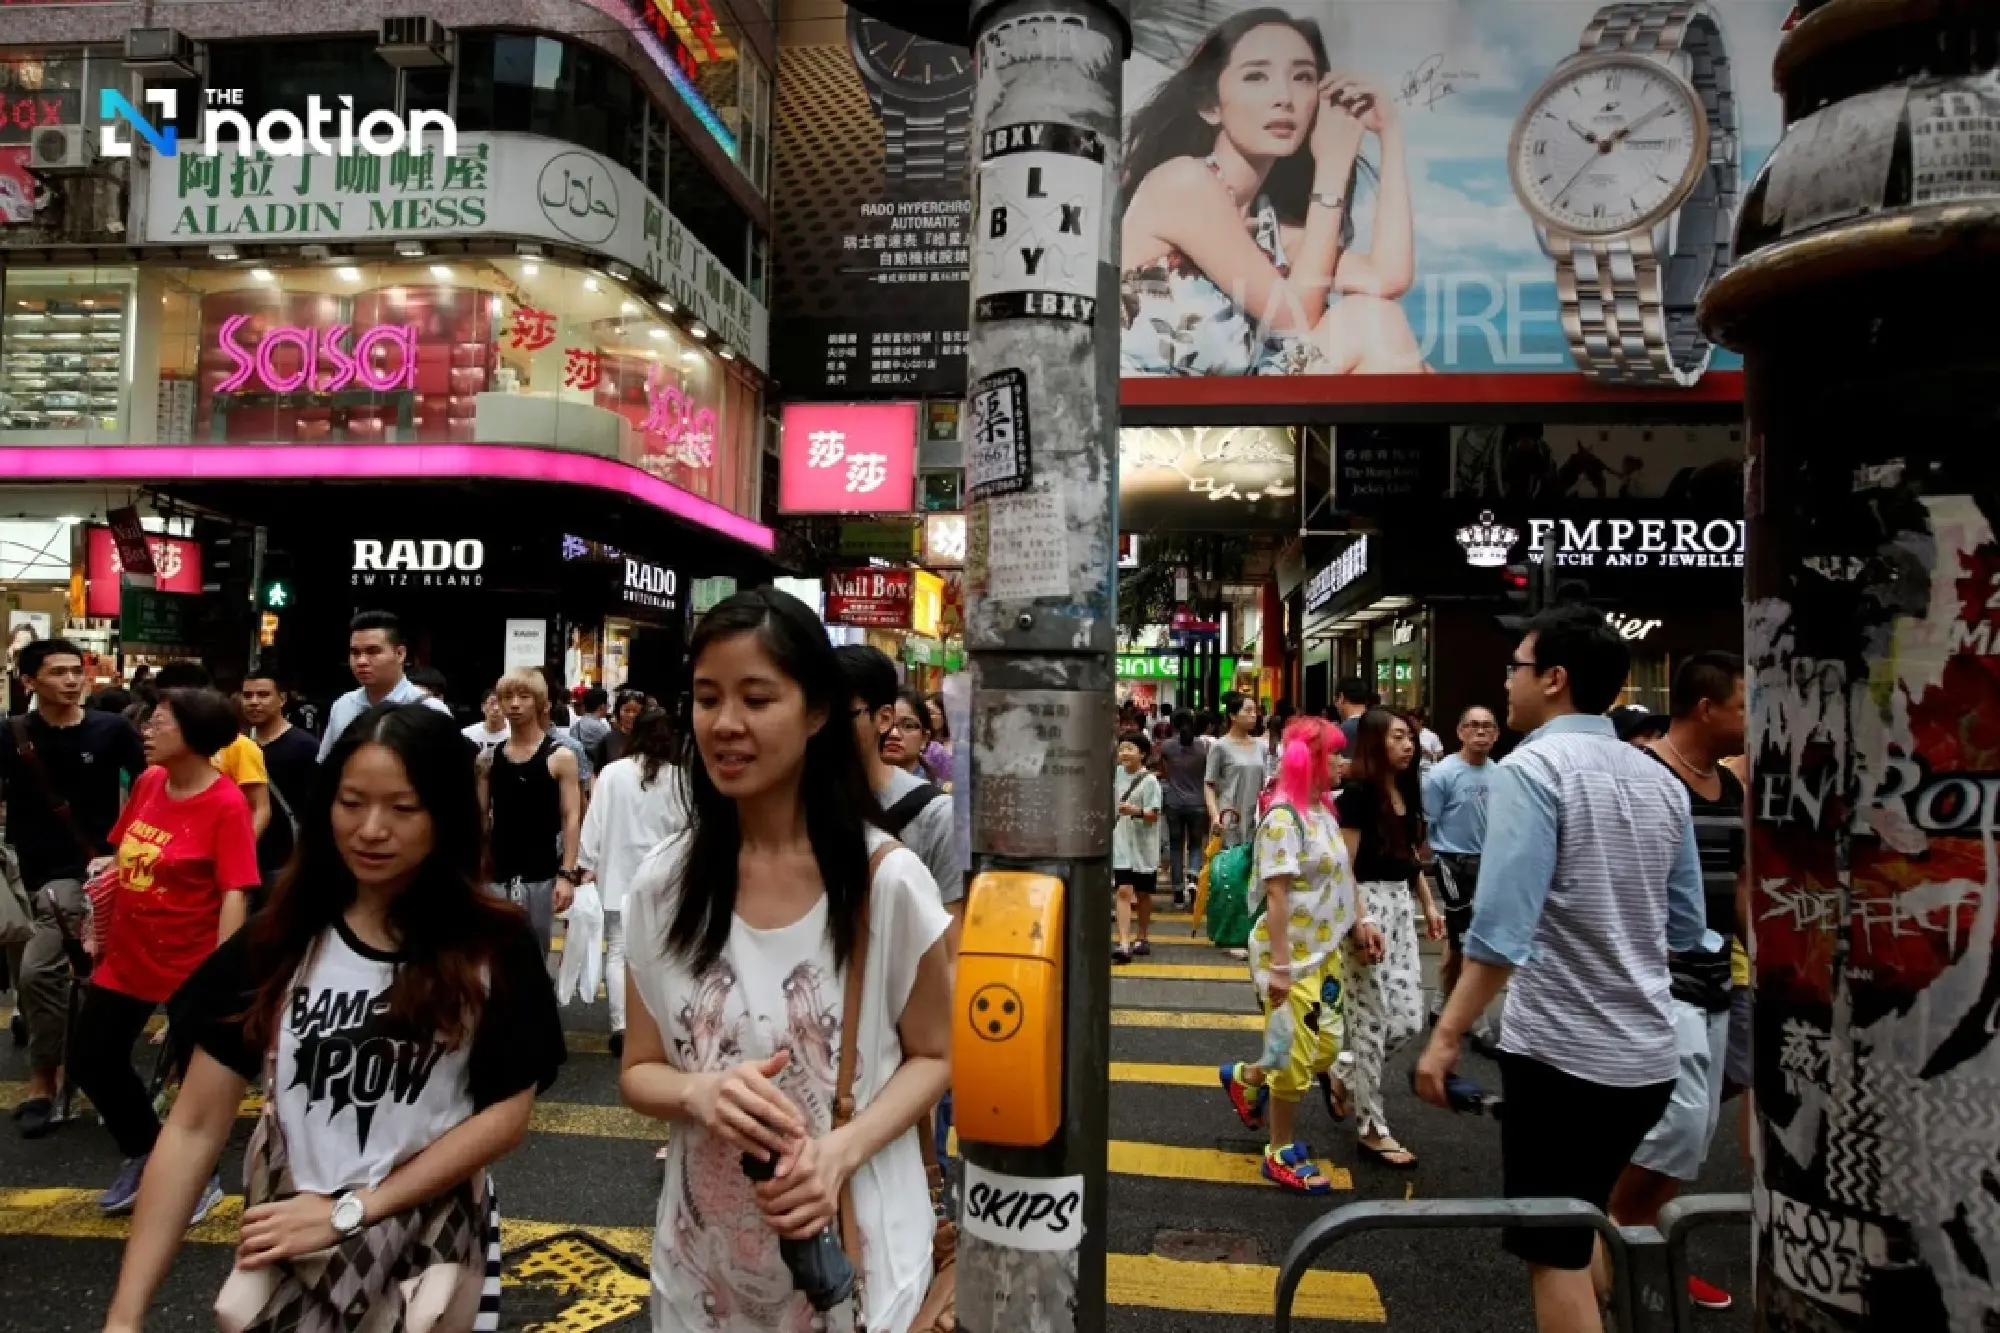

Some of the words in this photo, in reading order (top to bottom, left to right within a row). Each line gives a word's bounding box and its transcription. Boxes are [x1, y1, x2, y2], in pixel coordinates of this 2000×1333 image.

[984, 123, 1044, 155] LBXY
[1026, 167, 1048, 198] L
[171, 201, 343, 235] ALADIN
[367, 196, 487, 232] MESS
[860, 203, 895, 216] RADO
[891, 216, 960, 230] AUTOMATIC
[990, 206, 1008, 238] B
[1058, 203, 1082, 235] X
[1020, 247, 1045, 275] Y
[807, 430, 888, 493] 莎莎
[352, 538, 484, 571] RADO
[1527, 553, 1594, 567] WTCH
[1605, 553, 1648, 567] AND
[1658, 553, 1747, 567] JEWELLE
[624, 558, 677, 597] RADO
[830, 573, 868, 597] Nail
[872, 573, 907, 598] Box
[310, 1036, 446, 1106] POW
[967, 1182, 1080, 1233] SKIPS
